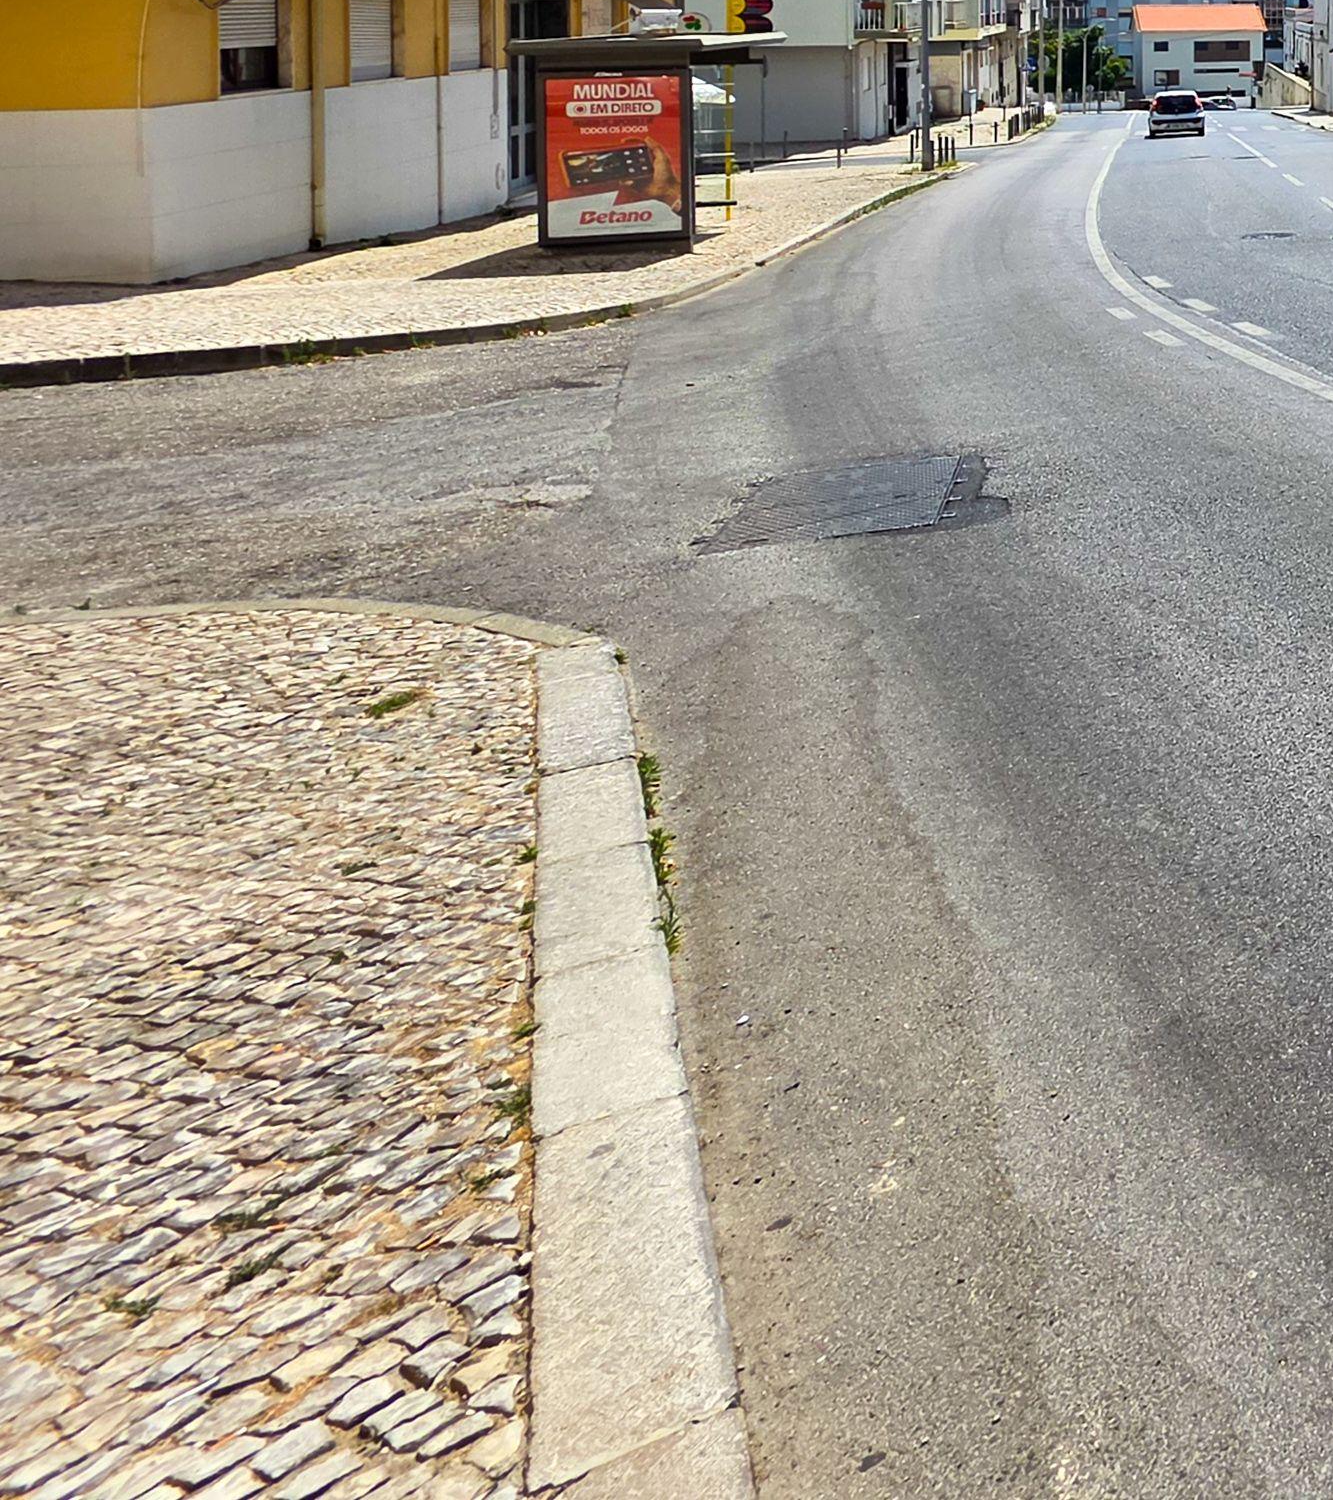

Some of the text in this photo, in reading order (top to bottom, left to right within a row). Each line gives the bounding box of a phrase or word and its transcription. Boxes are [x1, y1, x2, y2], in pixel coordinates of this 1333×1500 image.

[573, 82, 655, 100] MUNDIAL
[590, 101, 655, 114] EM DIRETO
[580, 125, 648, 135] TODOS OS JOGOS
[579, 209, 653, 225] Betano
